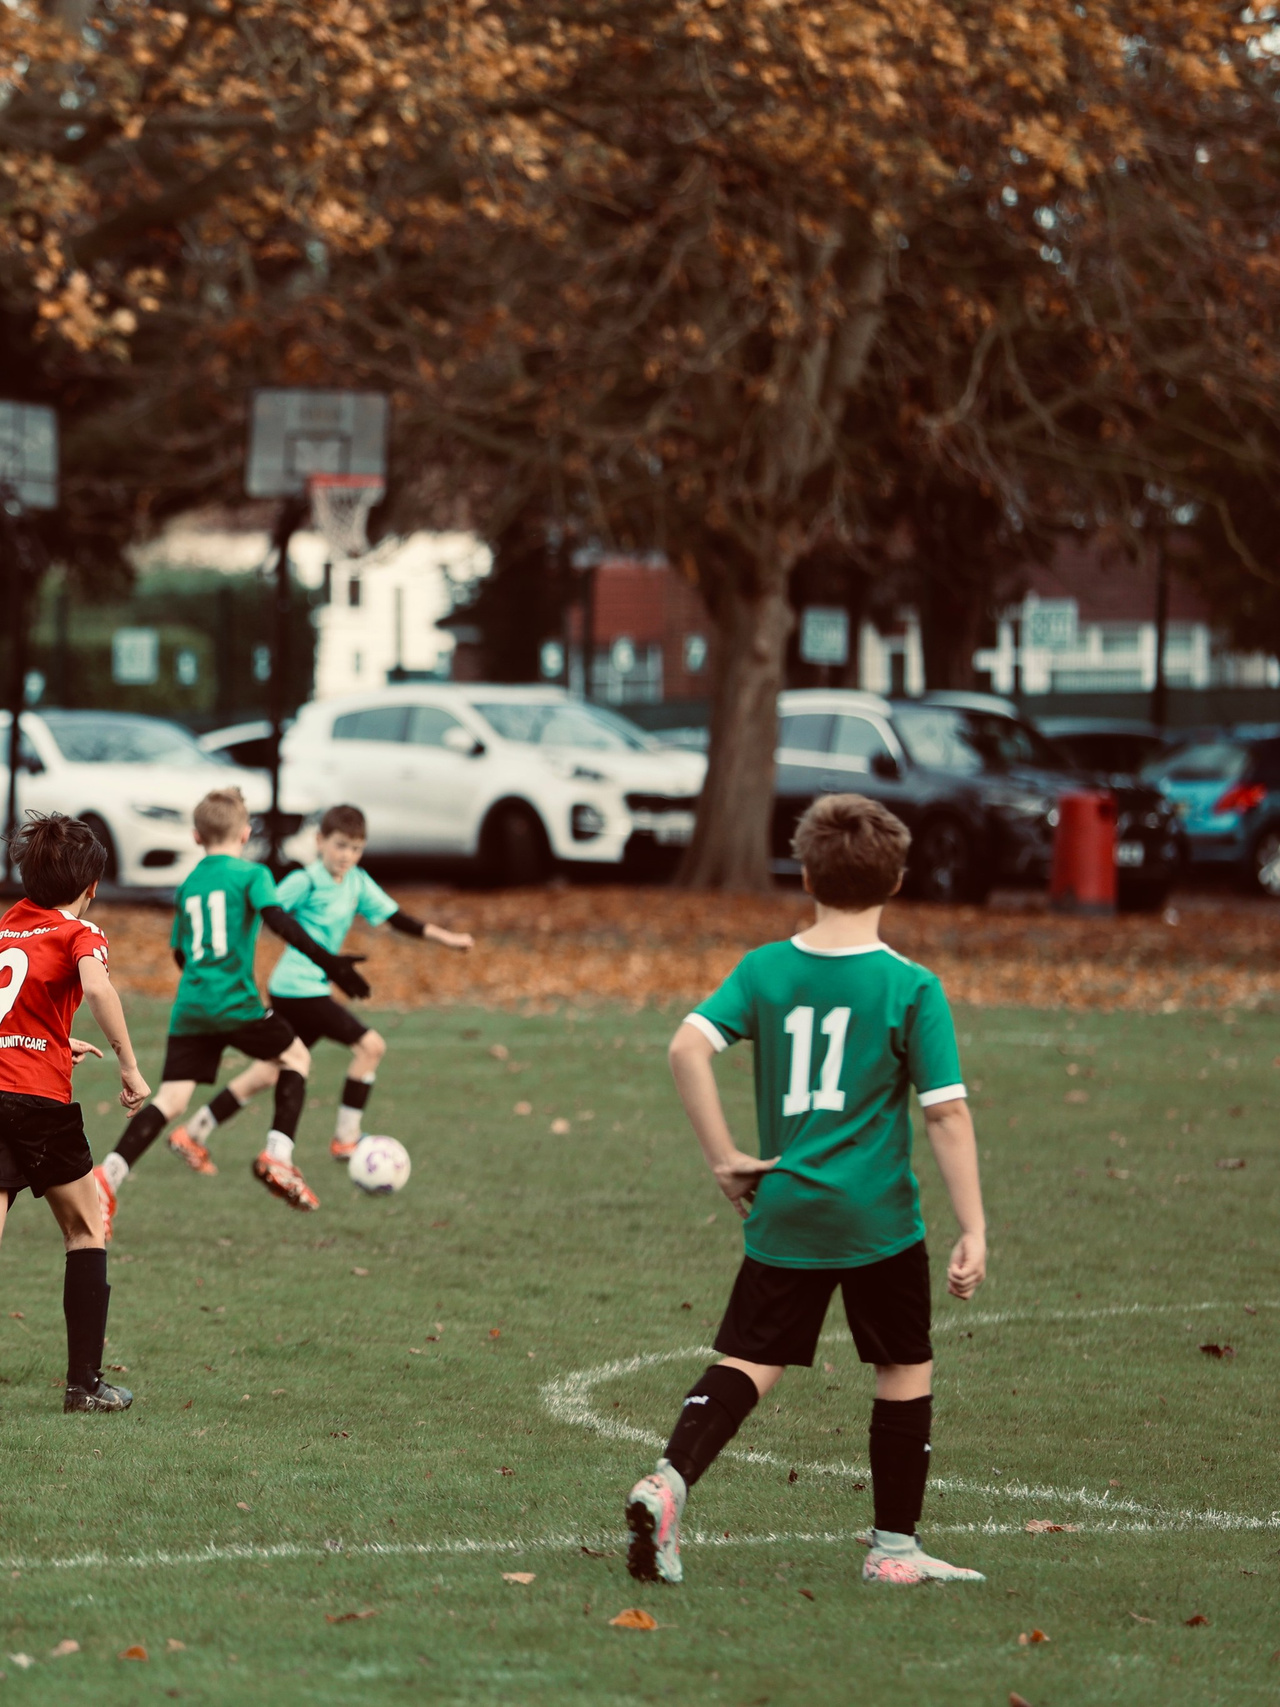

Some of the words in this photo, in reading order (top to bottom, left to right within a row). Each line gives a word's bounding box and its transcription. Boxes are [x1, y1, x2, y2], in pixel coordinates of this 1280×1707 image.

[185, 890, 228, 960] 11
[24, 1036, 47, 1052] CARE
[782, 1005, 852, 1117] 11
